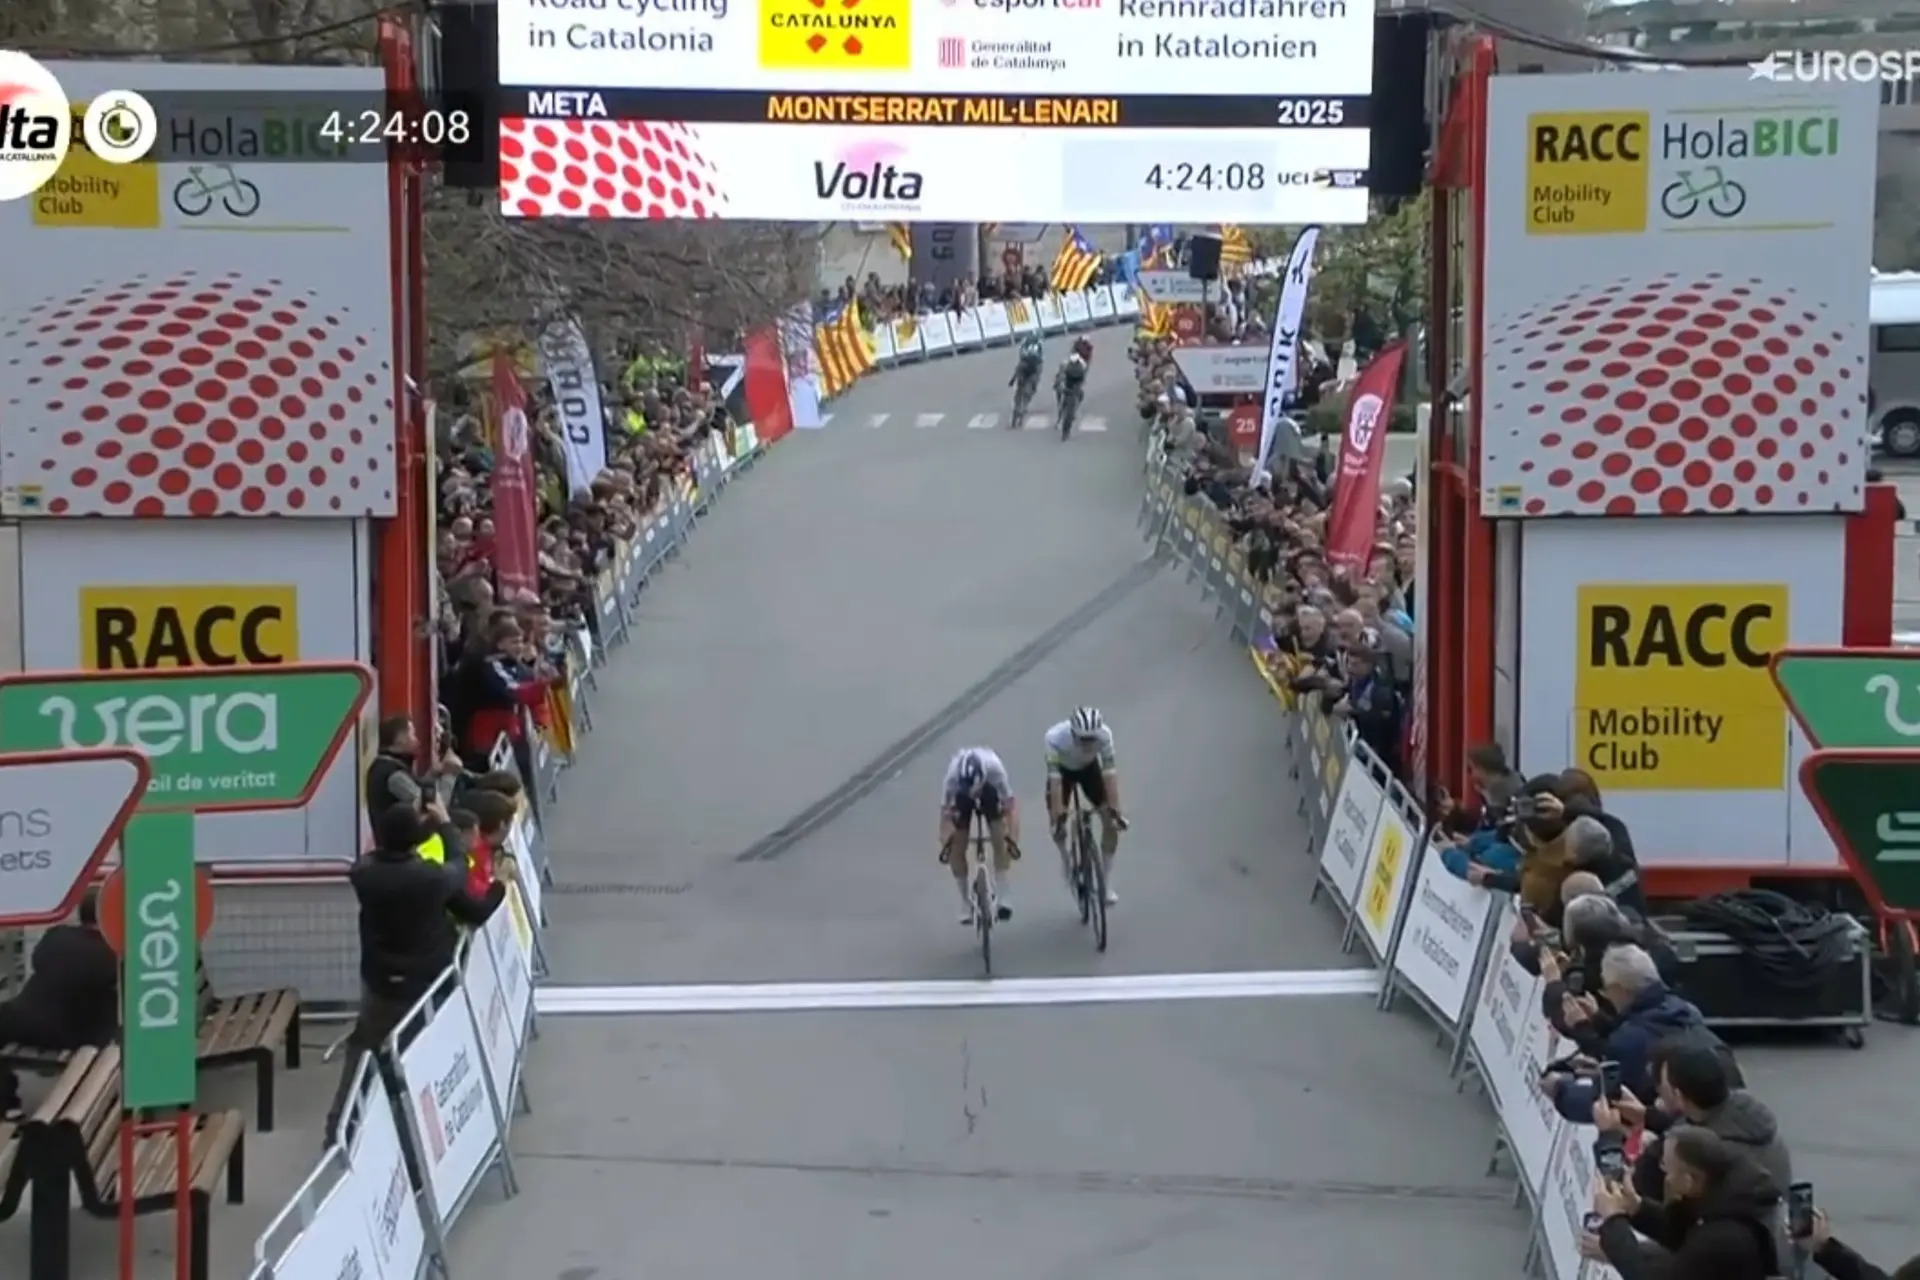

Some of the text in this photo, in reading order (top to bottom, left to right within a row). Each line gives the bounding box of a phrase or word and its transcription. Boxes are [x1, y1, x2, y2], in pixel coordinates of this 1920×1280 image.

[771, 13, 897, 28] CATALUNYA
[529, 22, 713, 51] in Catalonia
[971, 40, 1051, 53] Generalitat
[1117, 33, 1317, 59] in Katalonien
[971, 56, 1066, 72] de Catalunya
[528, 91, 608, 116] META
[767, 96, 1118, 124] MONTSERRAT MIL·LENARI
[1277, 100, 1344, 124] 2025
[1534, 123, 1641, 163] RACC
[1663, 117, 1839, 160] HolaBICI
[814, 160, 924, 200] Volta
[1145, 163, 1265, 191] 4:24:08
[1277, 171, 1309, 185] UCI
[39, 196, 83, 214] Club
[1533, 183, 1612, 206] Mobility
[1533, 205, 1575, 224] Club
[95, 605, 283, 669] RACC
[1591, 603, 1773, 668] RACC
[38, 690, 278, 757] vera
[1588, 707, 1723, 743] Mobility
[1588, 742, 1659, 770] Club
[208, 769, 276, 789] veritat
[0, 809, 51, 837] ns
[0, 850, 51, 872] ets
[139, 879, 181, 1028] vera
